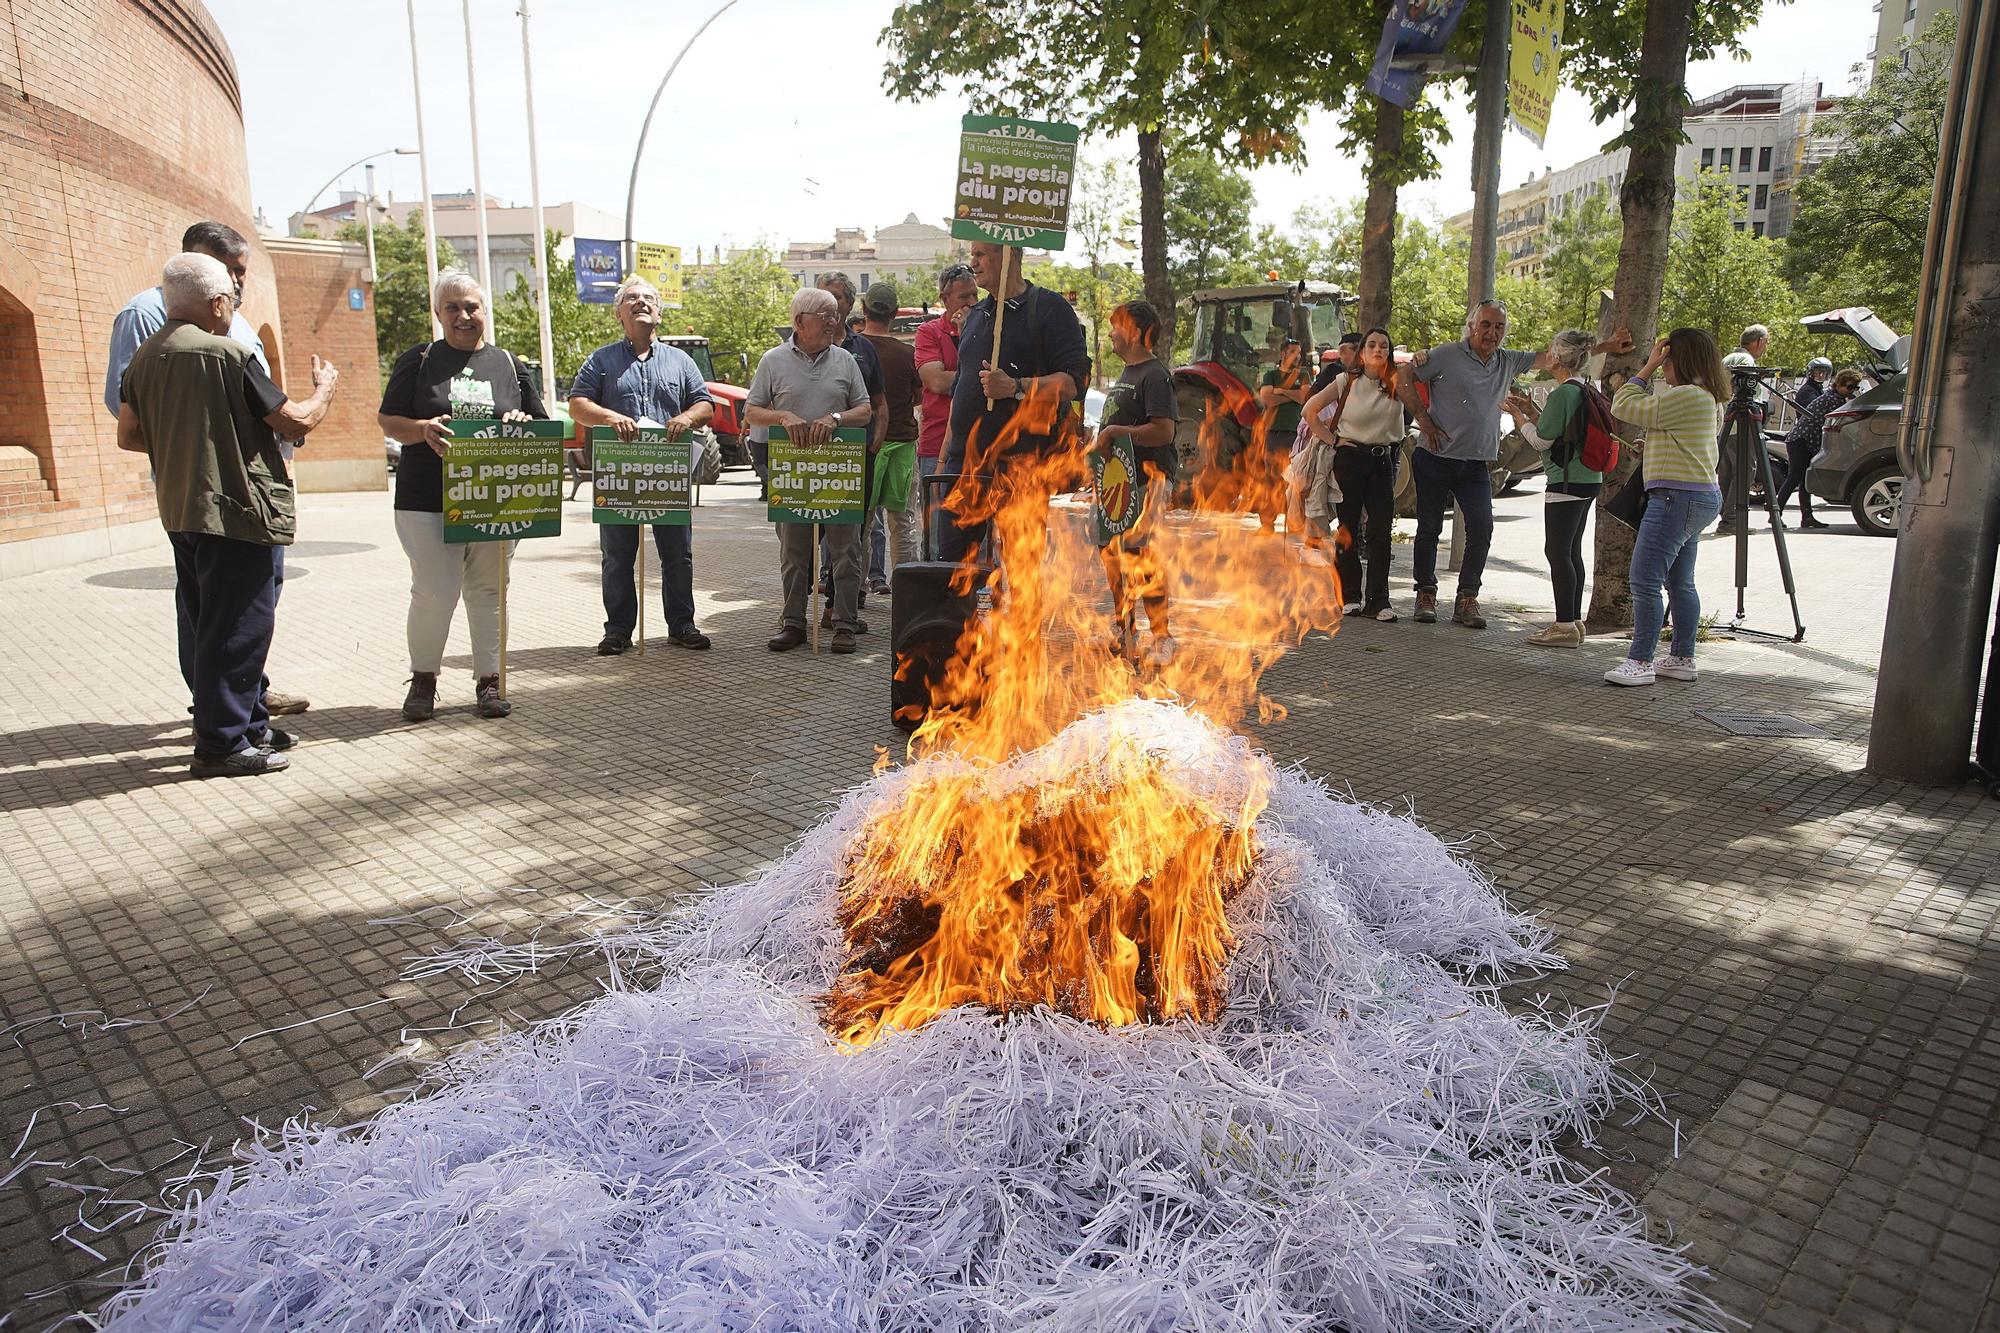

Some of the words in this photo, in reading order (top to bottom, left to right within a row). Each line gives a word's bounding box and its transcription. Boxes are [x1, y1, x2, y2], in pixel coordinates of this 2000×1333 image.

[968, 142, 975, 151] la
[977, 142, 1009, 154] inacció
[1012, 148, 1031, 157] dels
[1033, 151, 1070, 161] governs
[961, 157, 984, 174] La
[990, 164, 1069, 184] pagesia
[960, 177, 997, 200] diu
[1002, 185, 1067, 206] prou!
[974, 221, 1036, 241] ATALU
[473, 425, 499, 439] DE
[453, 448, 461, 456] la
[464, 447, 498, 456] inacció
[501, 447, 520, 455] dels
[522, 447, 559, 456] governs
[609, 448, 637, 456] inacció
[785, 447, 813, 455] inacció
[448, 463, 473, 478] La
[480, 458, 559, 480] pagesia
[596, 460, 616, 472] La
[621, 460, 688, 476] pagesia
[772, 459, 791, 471] La
[796, 459, 862, 475] pagesia
[596, 474, 629, 490] diu
[635, 478, 688, 494] prou!
[772, 473, 803, 489] diu
[810, 477, 861, 493] prou!
[448, 480, 488, 500] diu
[496, 480, 559, 503] prou!
[613, 508, 666, 520] ATALU
[788, 508, 839, 520] ATALU
[471, 521, 533, 535] ATALU
